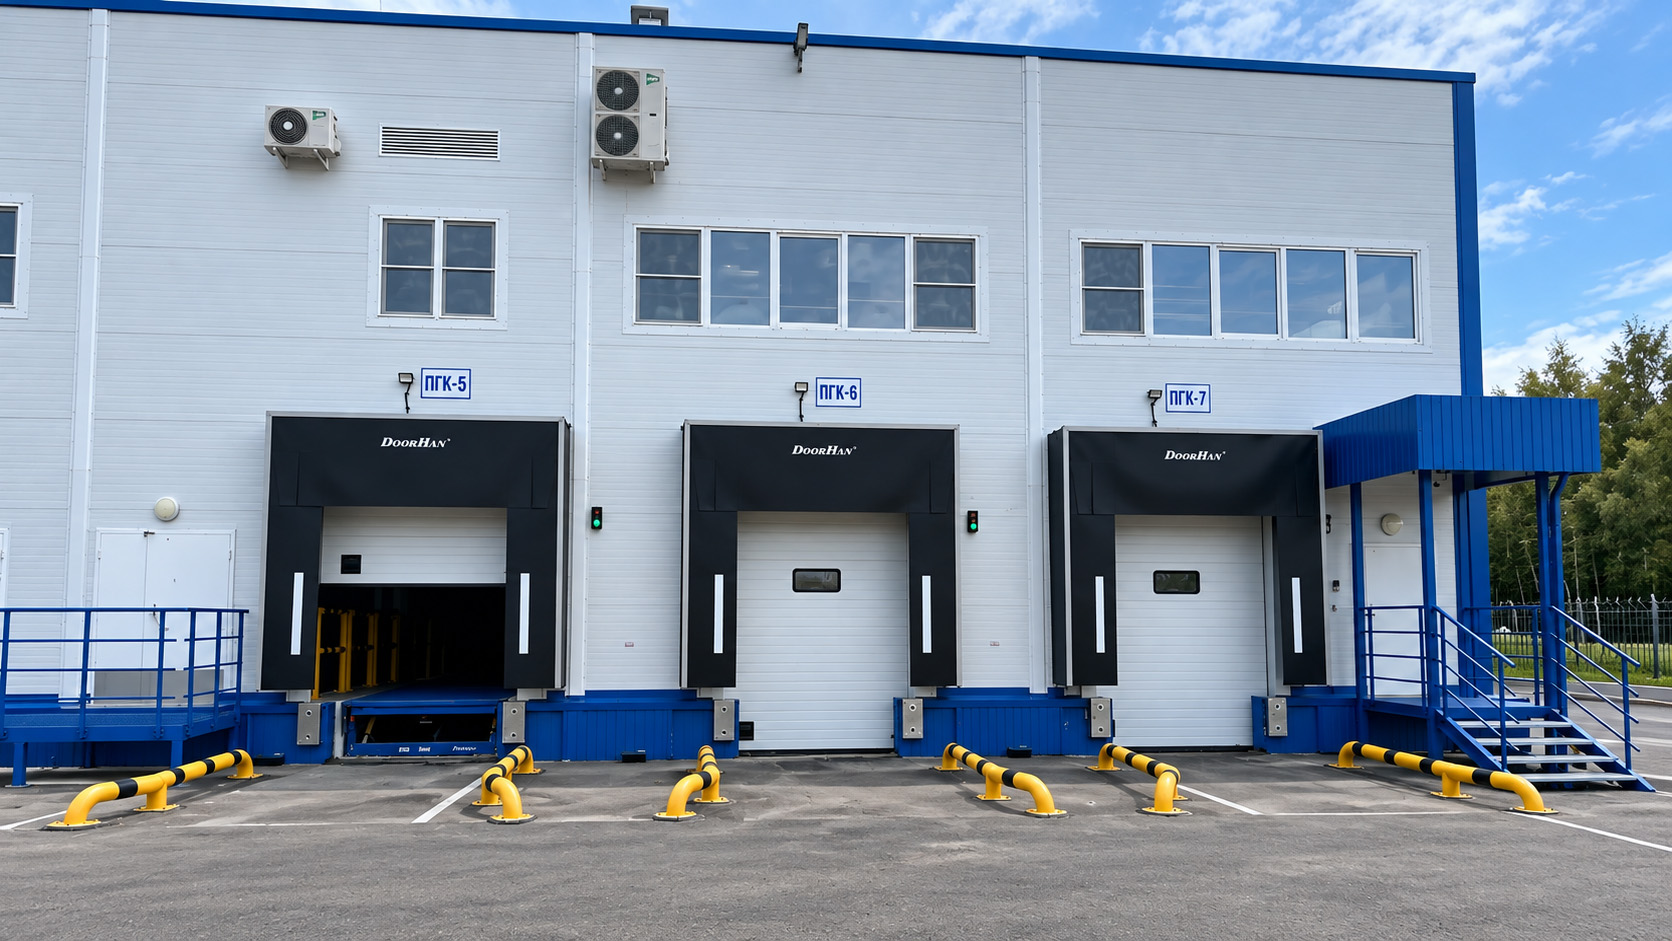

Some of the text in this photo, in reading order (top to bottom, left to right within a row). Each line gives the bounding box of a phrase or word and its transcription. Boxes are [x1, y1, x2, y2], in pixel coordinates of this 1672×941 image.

[424, 374, 467, 392] ПГК-5
[819, 383, 858, 401] ПГК-6
[1169, 390, 1207, 407] ПГК-7
